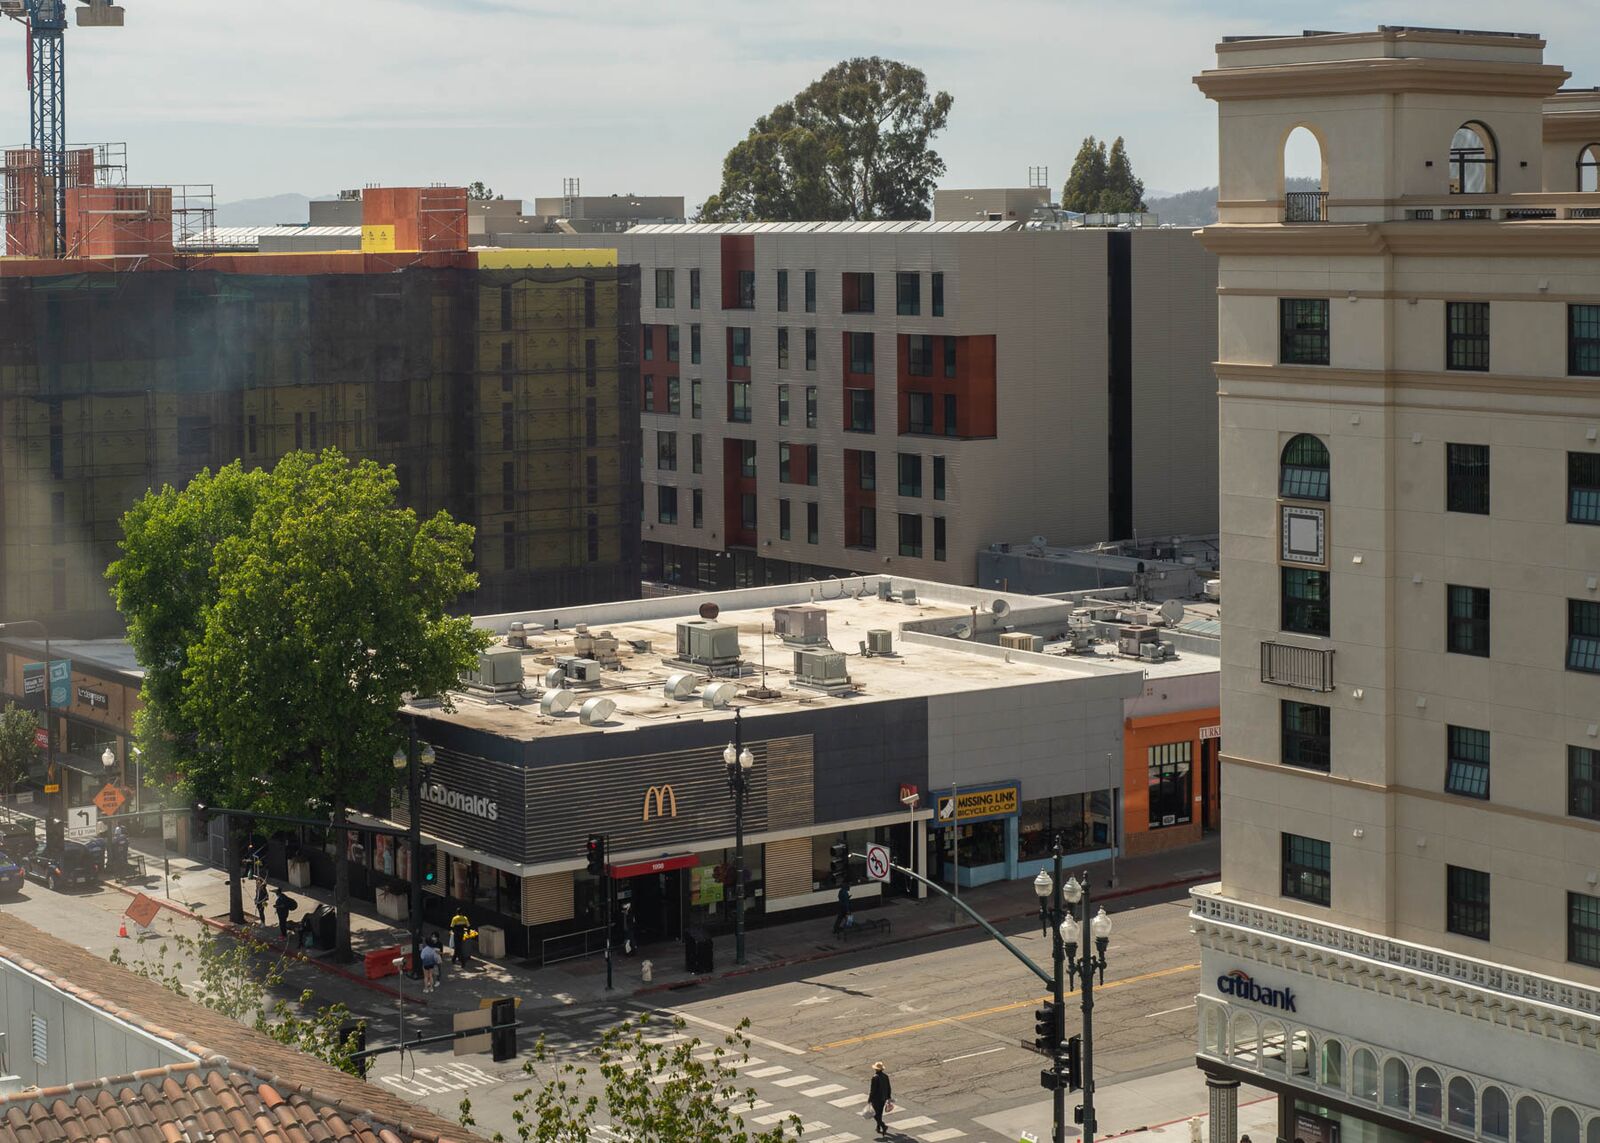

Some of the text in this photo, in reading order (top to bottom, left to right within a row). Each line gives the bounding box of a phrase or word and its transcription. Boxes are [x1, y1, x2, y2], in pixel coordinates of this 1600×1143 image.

[957, 791, 1015, 808] MISSING LINK
[957, 803, 1015, 816] BICYCLE CO-OP
[1217, 972, 1297, 1012] citibank
[380, 1062, 504, 1096] CLEAR
